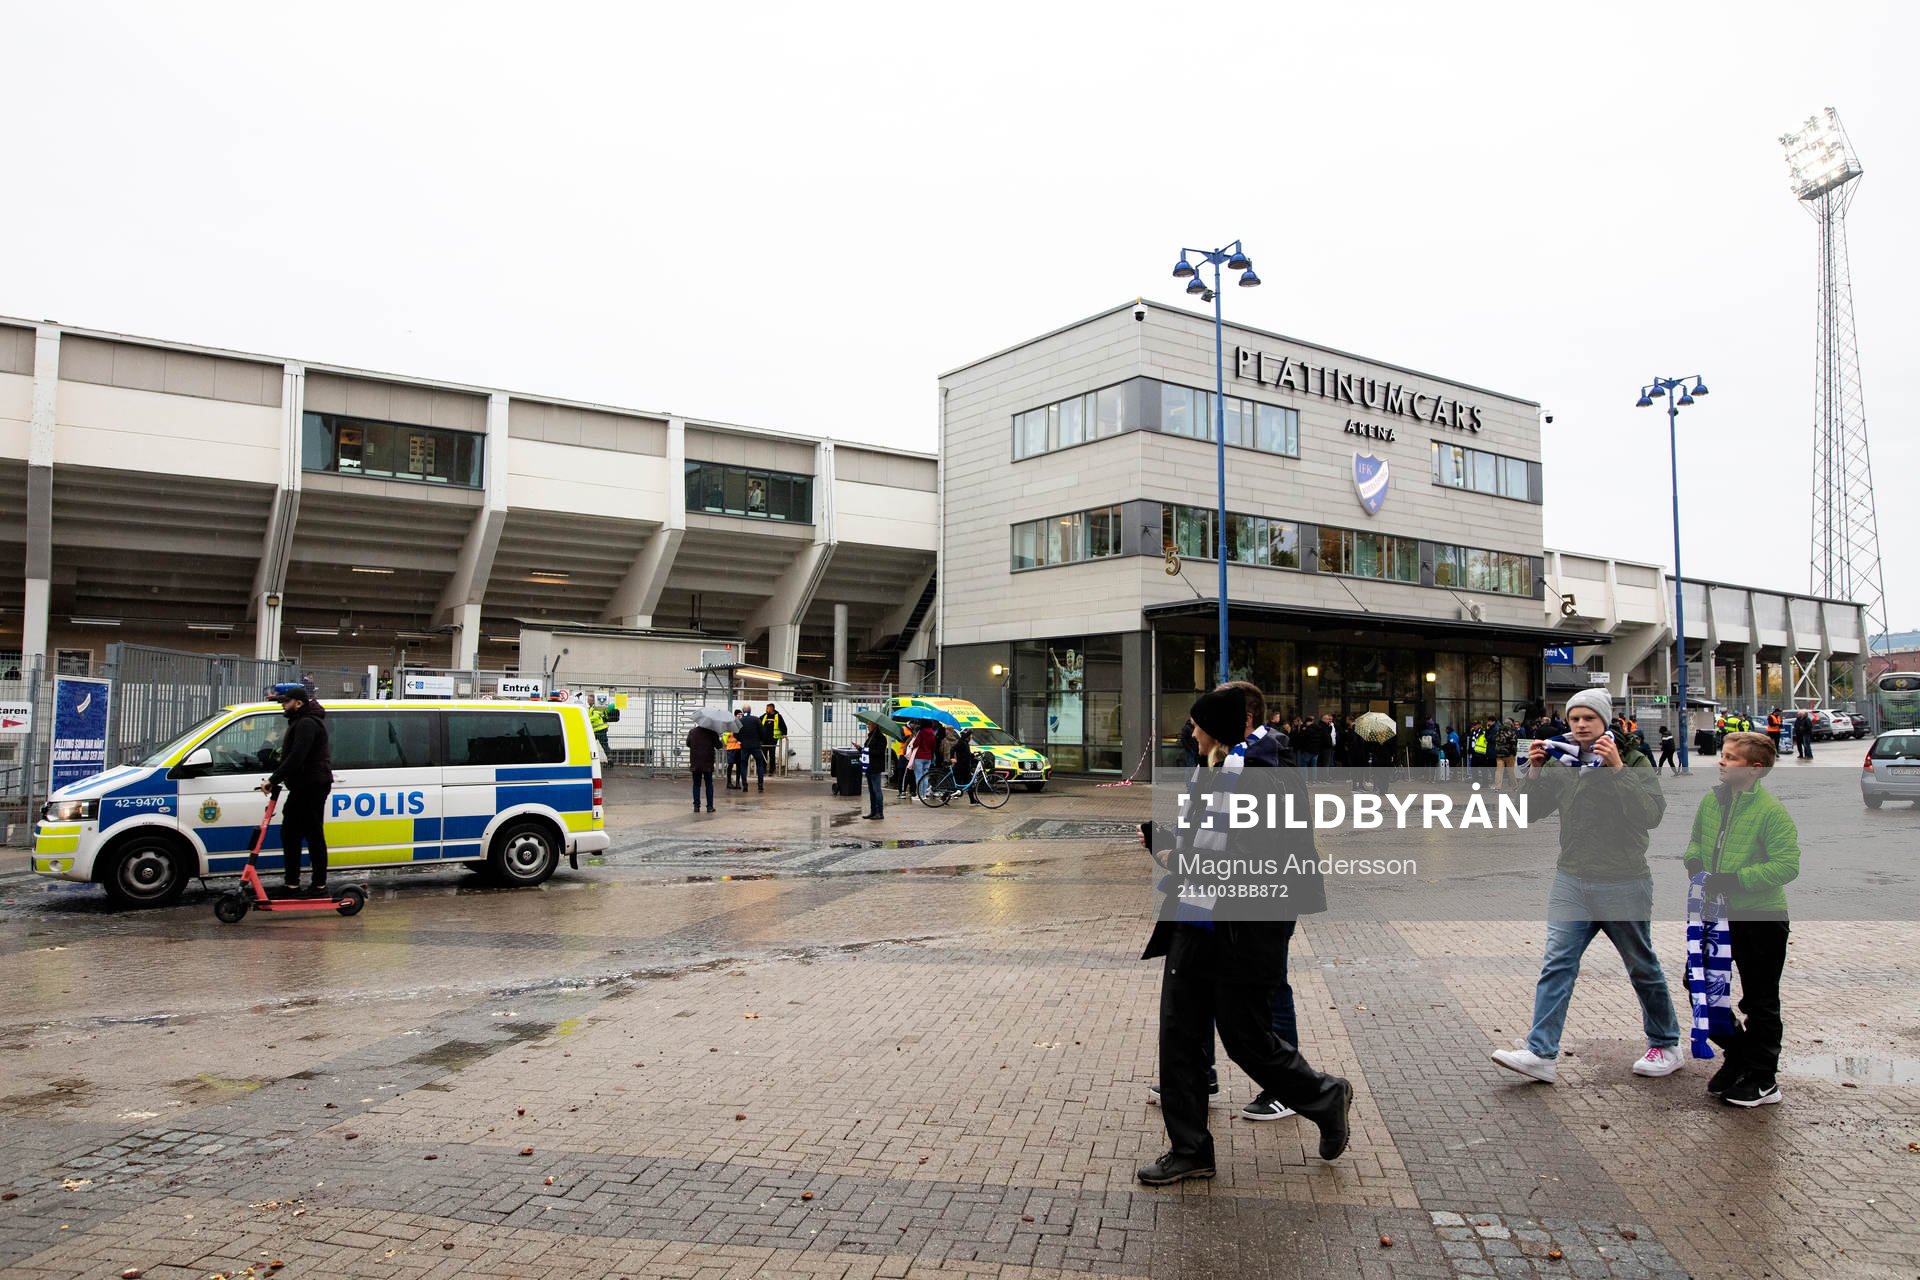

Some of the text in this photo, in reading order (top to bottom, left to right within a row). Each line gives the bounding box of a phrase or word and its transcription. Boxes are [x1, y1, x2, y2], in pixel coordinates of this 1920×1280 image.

[1235, 346, 1483, 433] PLATINUMCARS
[1344, 419, 1397, 442] ARENA
[1165, 546, 1181, 576] 5
[502, 684, 530, 692] Entré
[114, 797, 165, 808] 42-9470
[331, 791, 425, 818] POLIS
